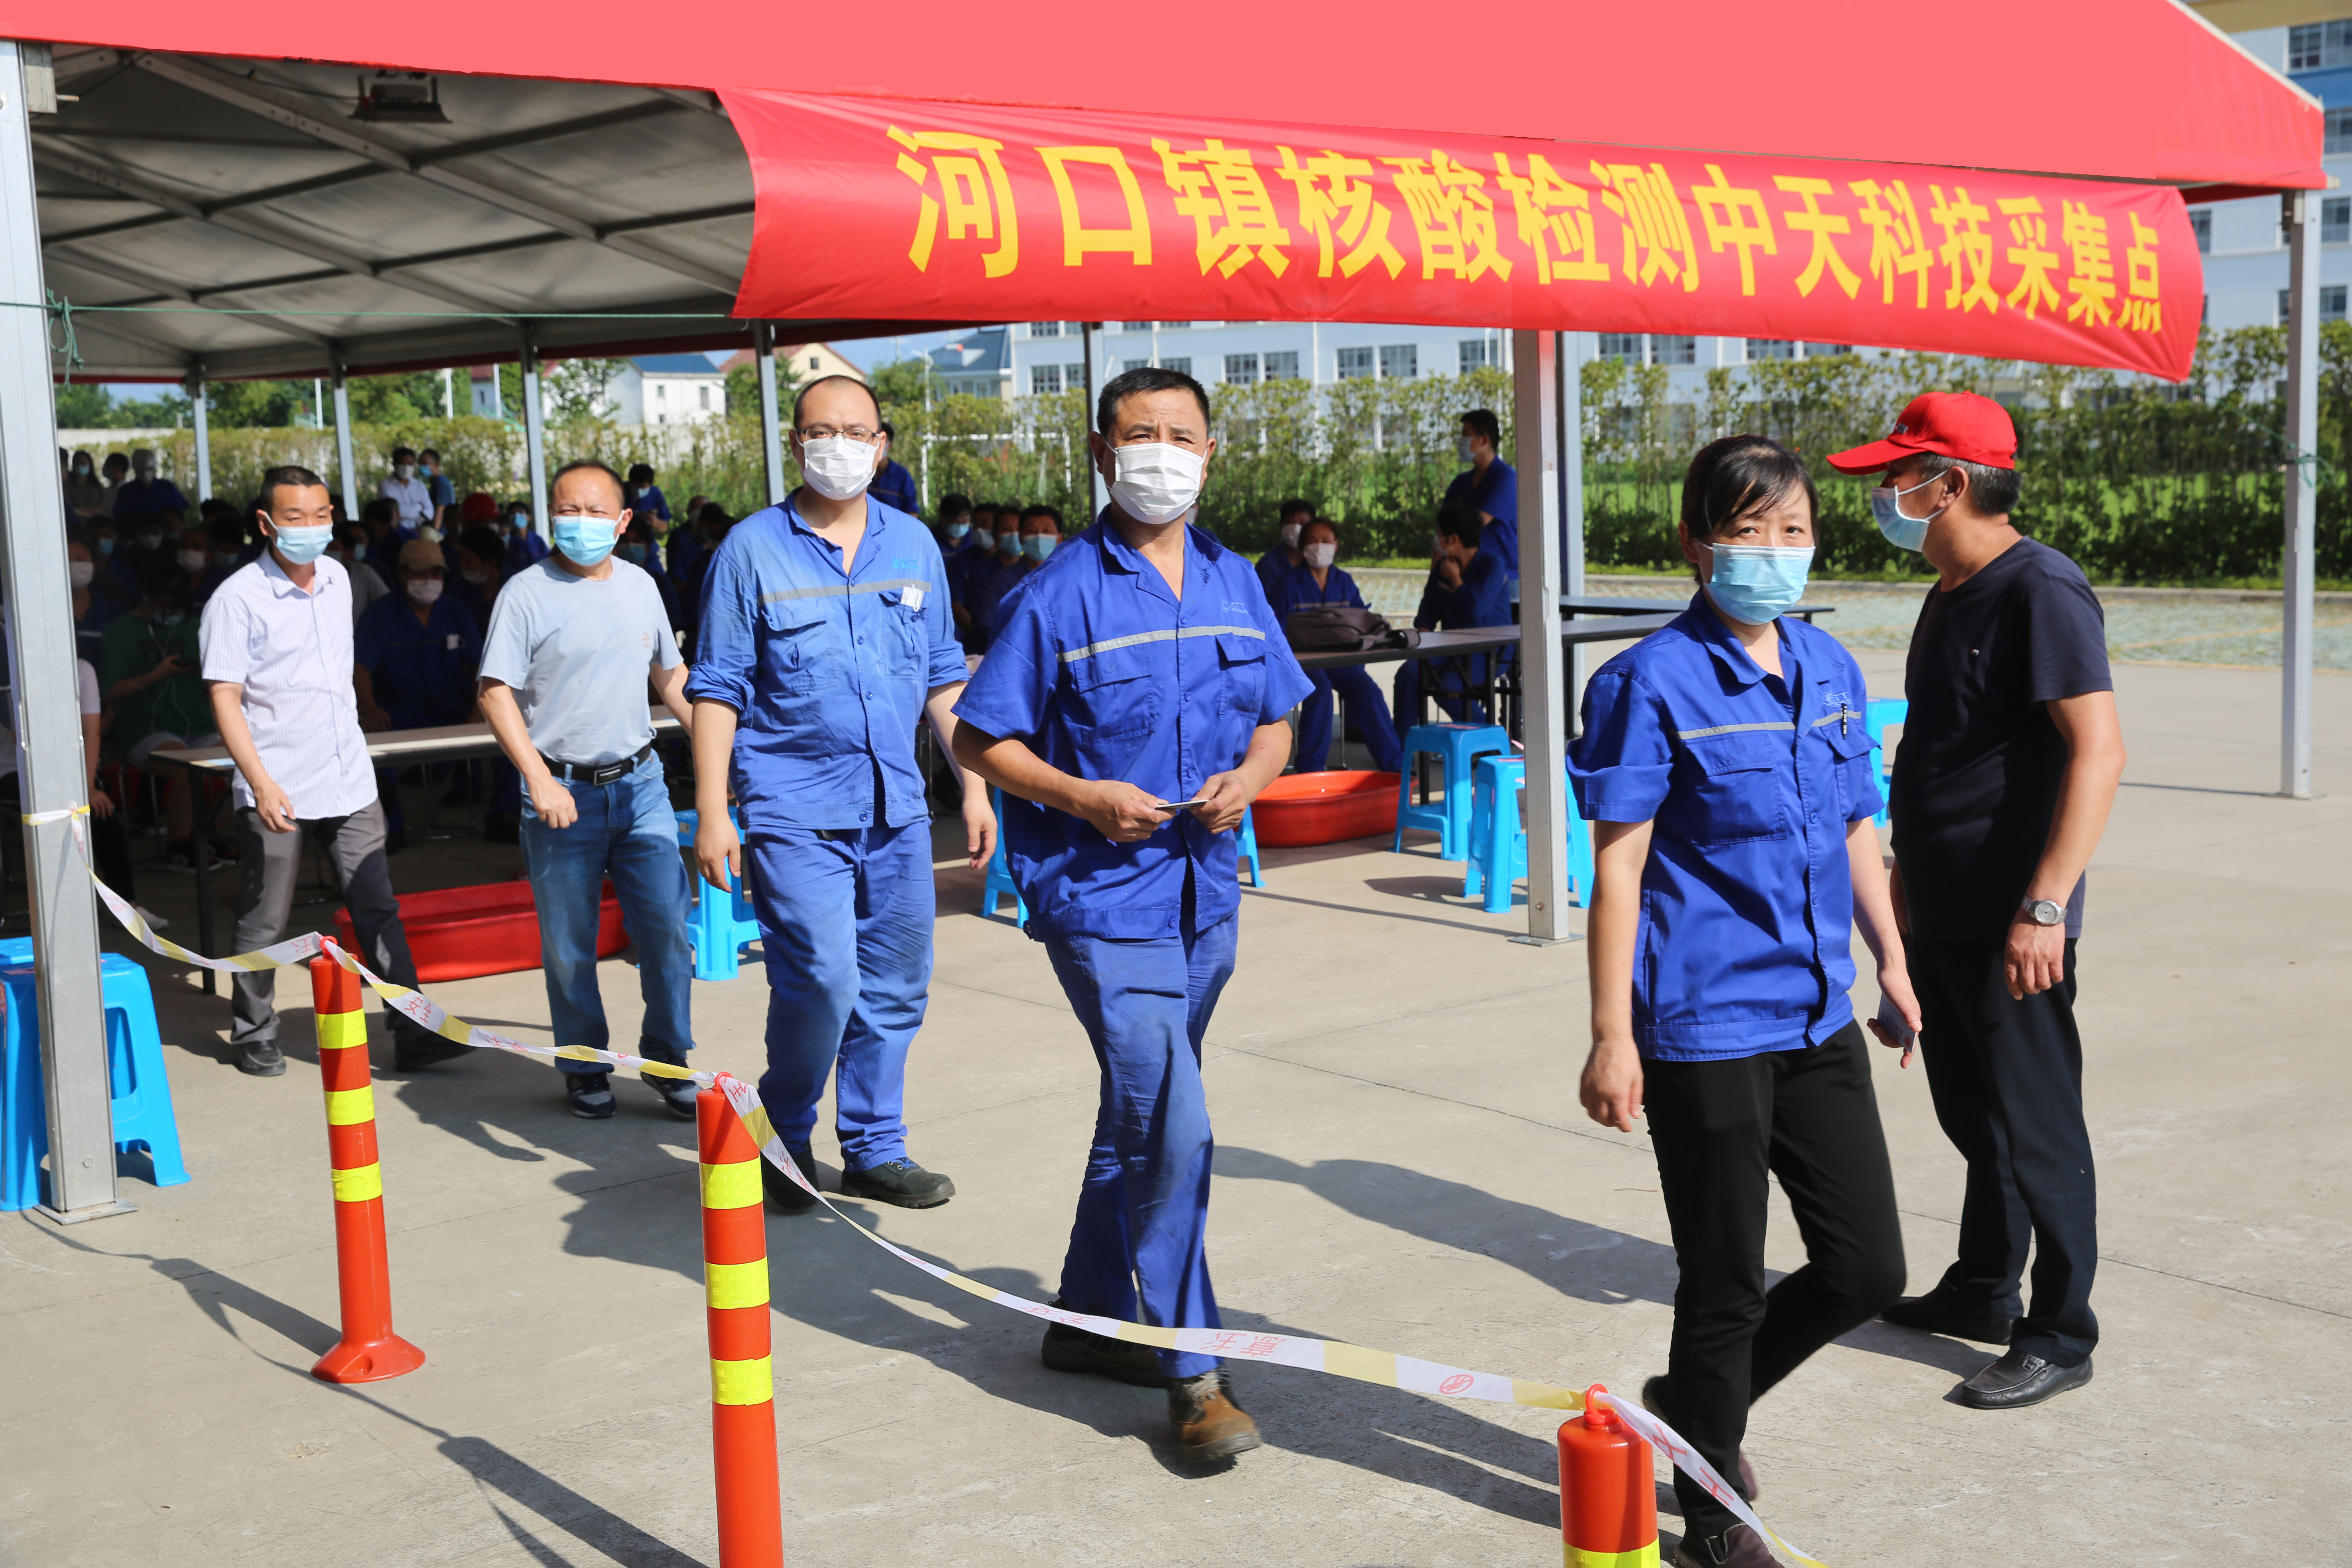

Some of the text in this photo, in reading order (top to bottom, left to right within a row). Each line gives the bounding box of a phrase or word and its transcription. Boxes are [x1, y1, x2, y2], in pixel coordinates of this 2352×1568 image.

[886, 125, 2163, 332] 河口镇核酸检测中天科技采集点
[404, 996, 432, 1023] 安全
